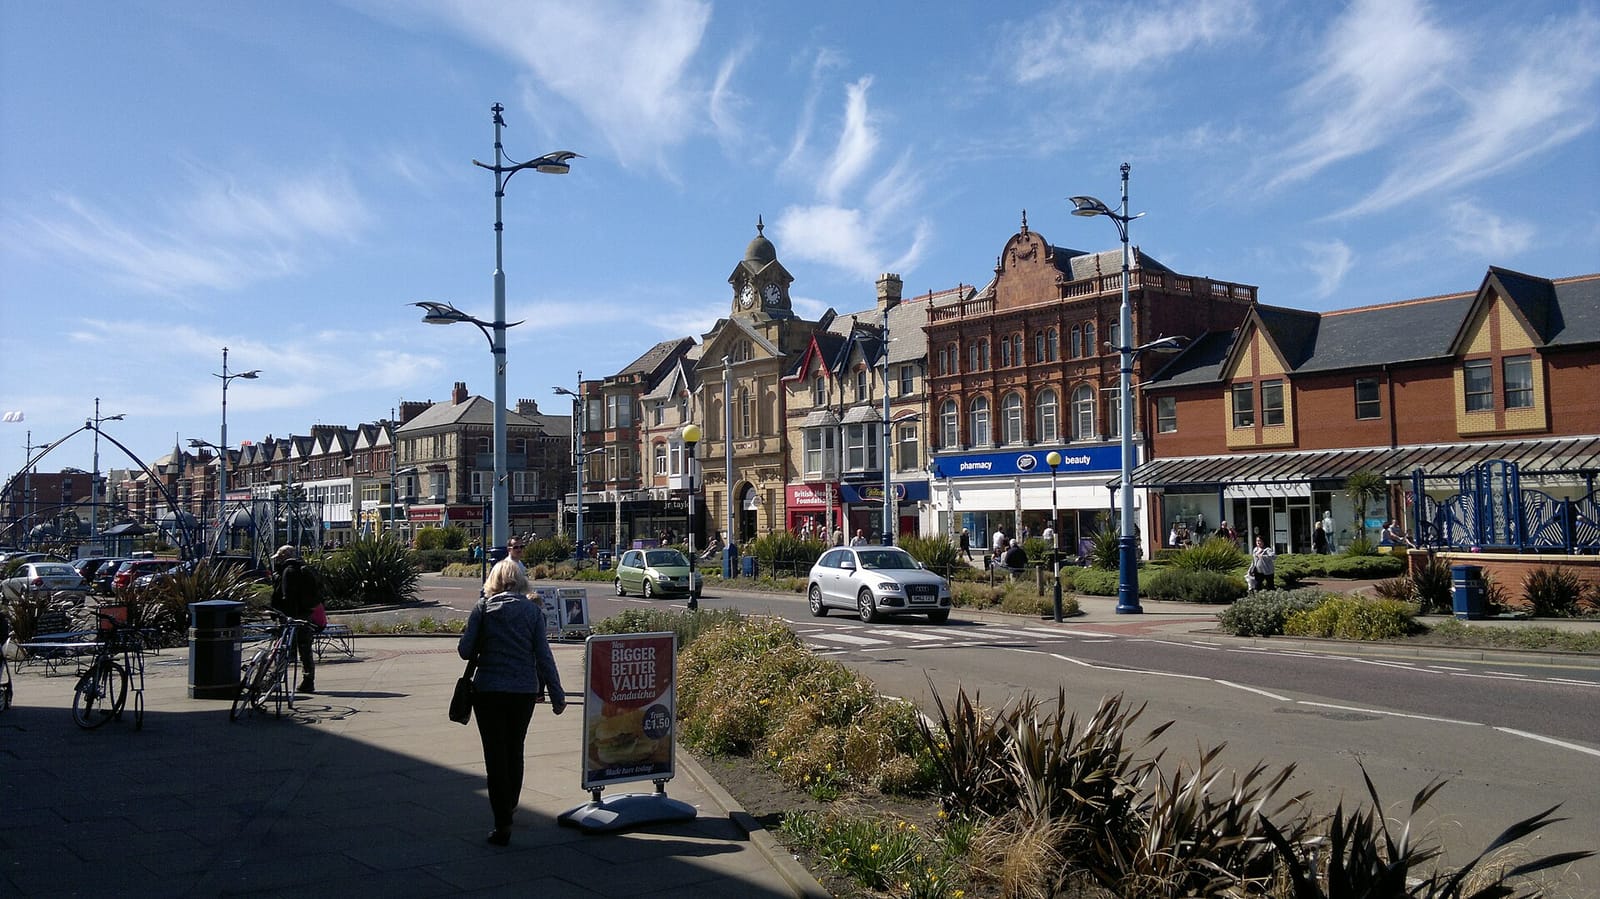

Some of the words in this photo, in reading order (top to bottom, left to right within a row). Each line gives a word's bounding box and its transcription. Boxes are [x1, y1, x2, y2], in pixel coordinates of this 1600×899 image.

[1065, 455, 1091, 465] beauty
[960, 461, 992, 471] pharmacy
[794, 489, 814, 498] British
[663, 501, 671, 510] jr
[796, 497, 826, 505] Foundatio
[611, 647, 656, 663] BIGGER
[611, 660, 656, 676] BETTER
[611, 674, 656, 691] VALUE
[611, 690, 656, 702] Sandwiches
[644, 717, 670, 730] £1.50
